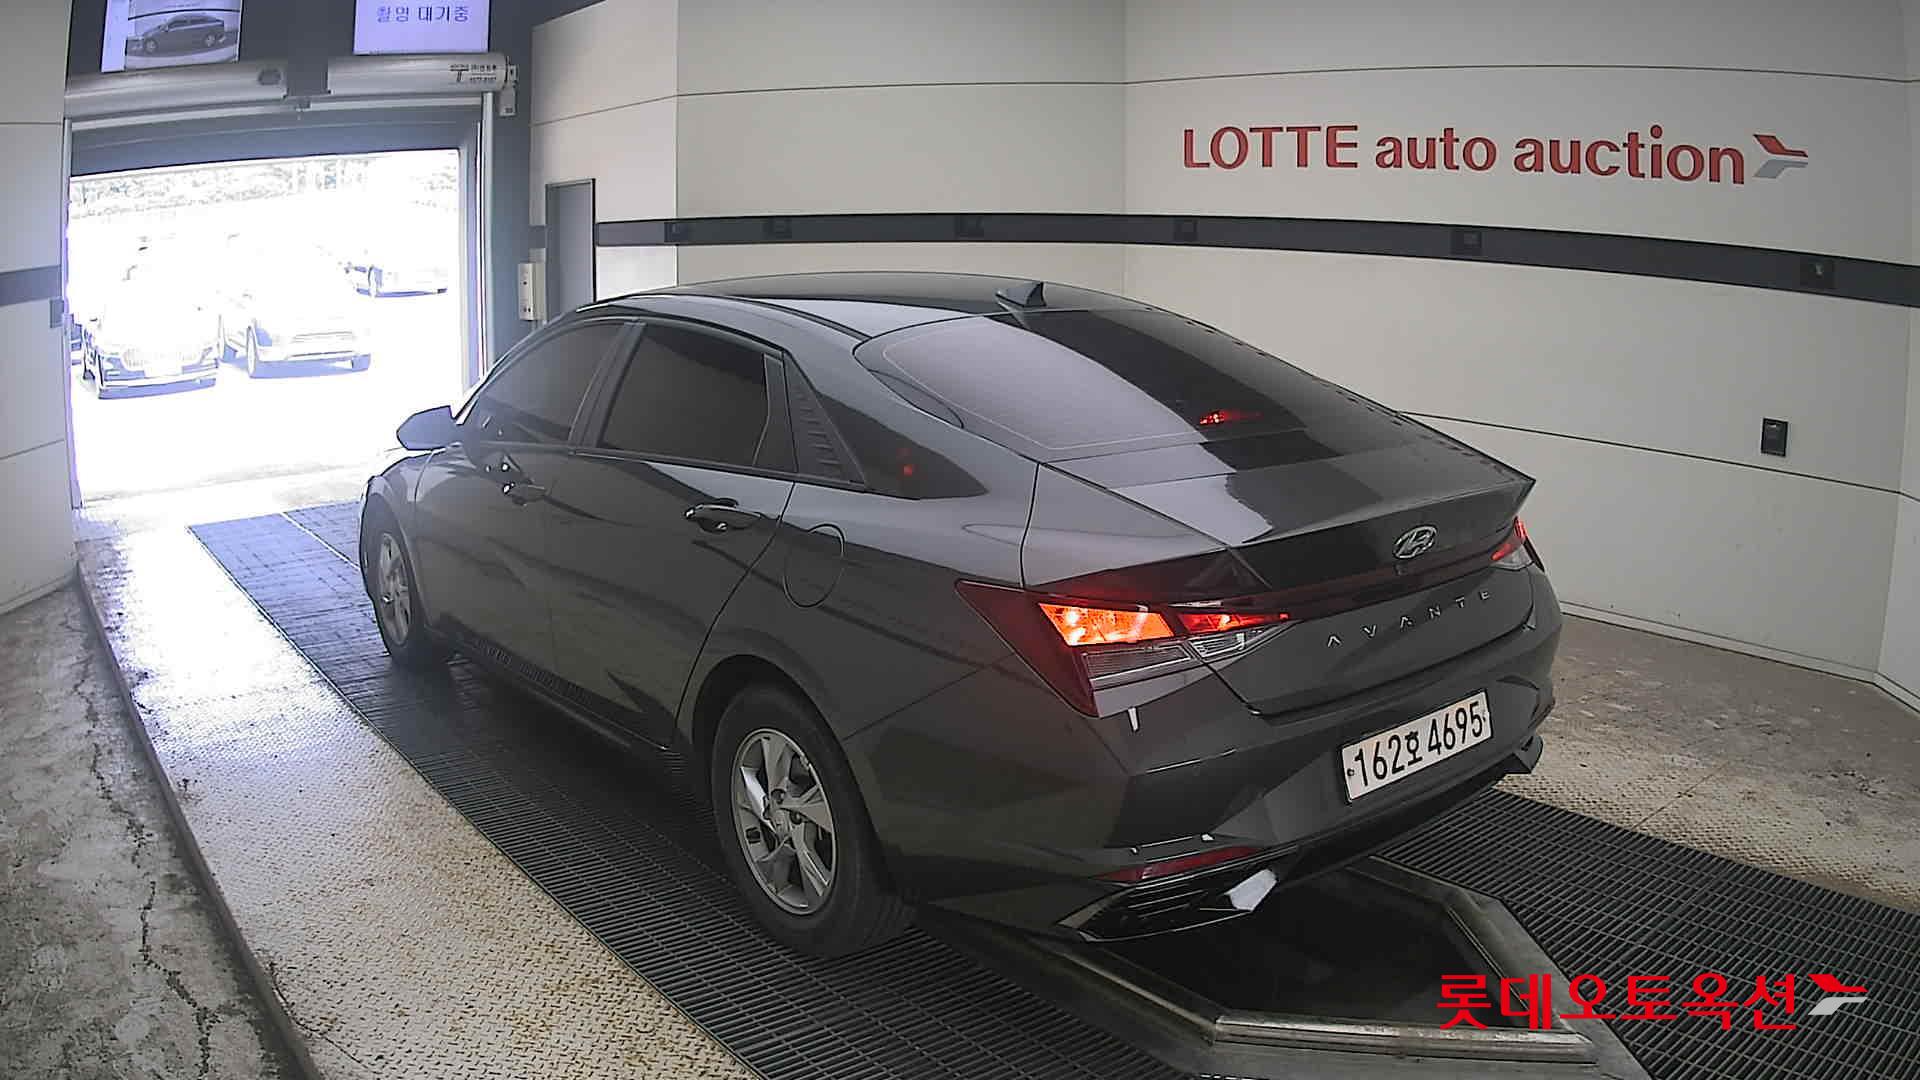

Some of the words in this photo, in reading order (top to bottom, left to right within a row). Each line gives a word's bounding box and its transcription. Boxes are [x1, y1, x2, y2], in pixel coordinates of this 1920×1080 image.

[418, 5, 469, 23] 대기중
[1184, 126, 1358, 169] LOTTE
[1376, 127, 1497, 171] auto
[1514, 125, 1744, 184] auction
[1327, 589, 1491, 648] AVANTE
[1354, 731, 1423, 786] 162호
[1428, 701, 1483, 755] 4695
